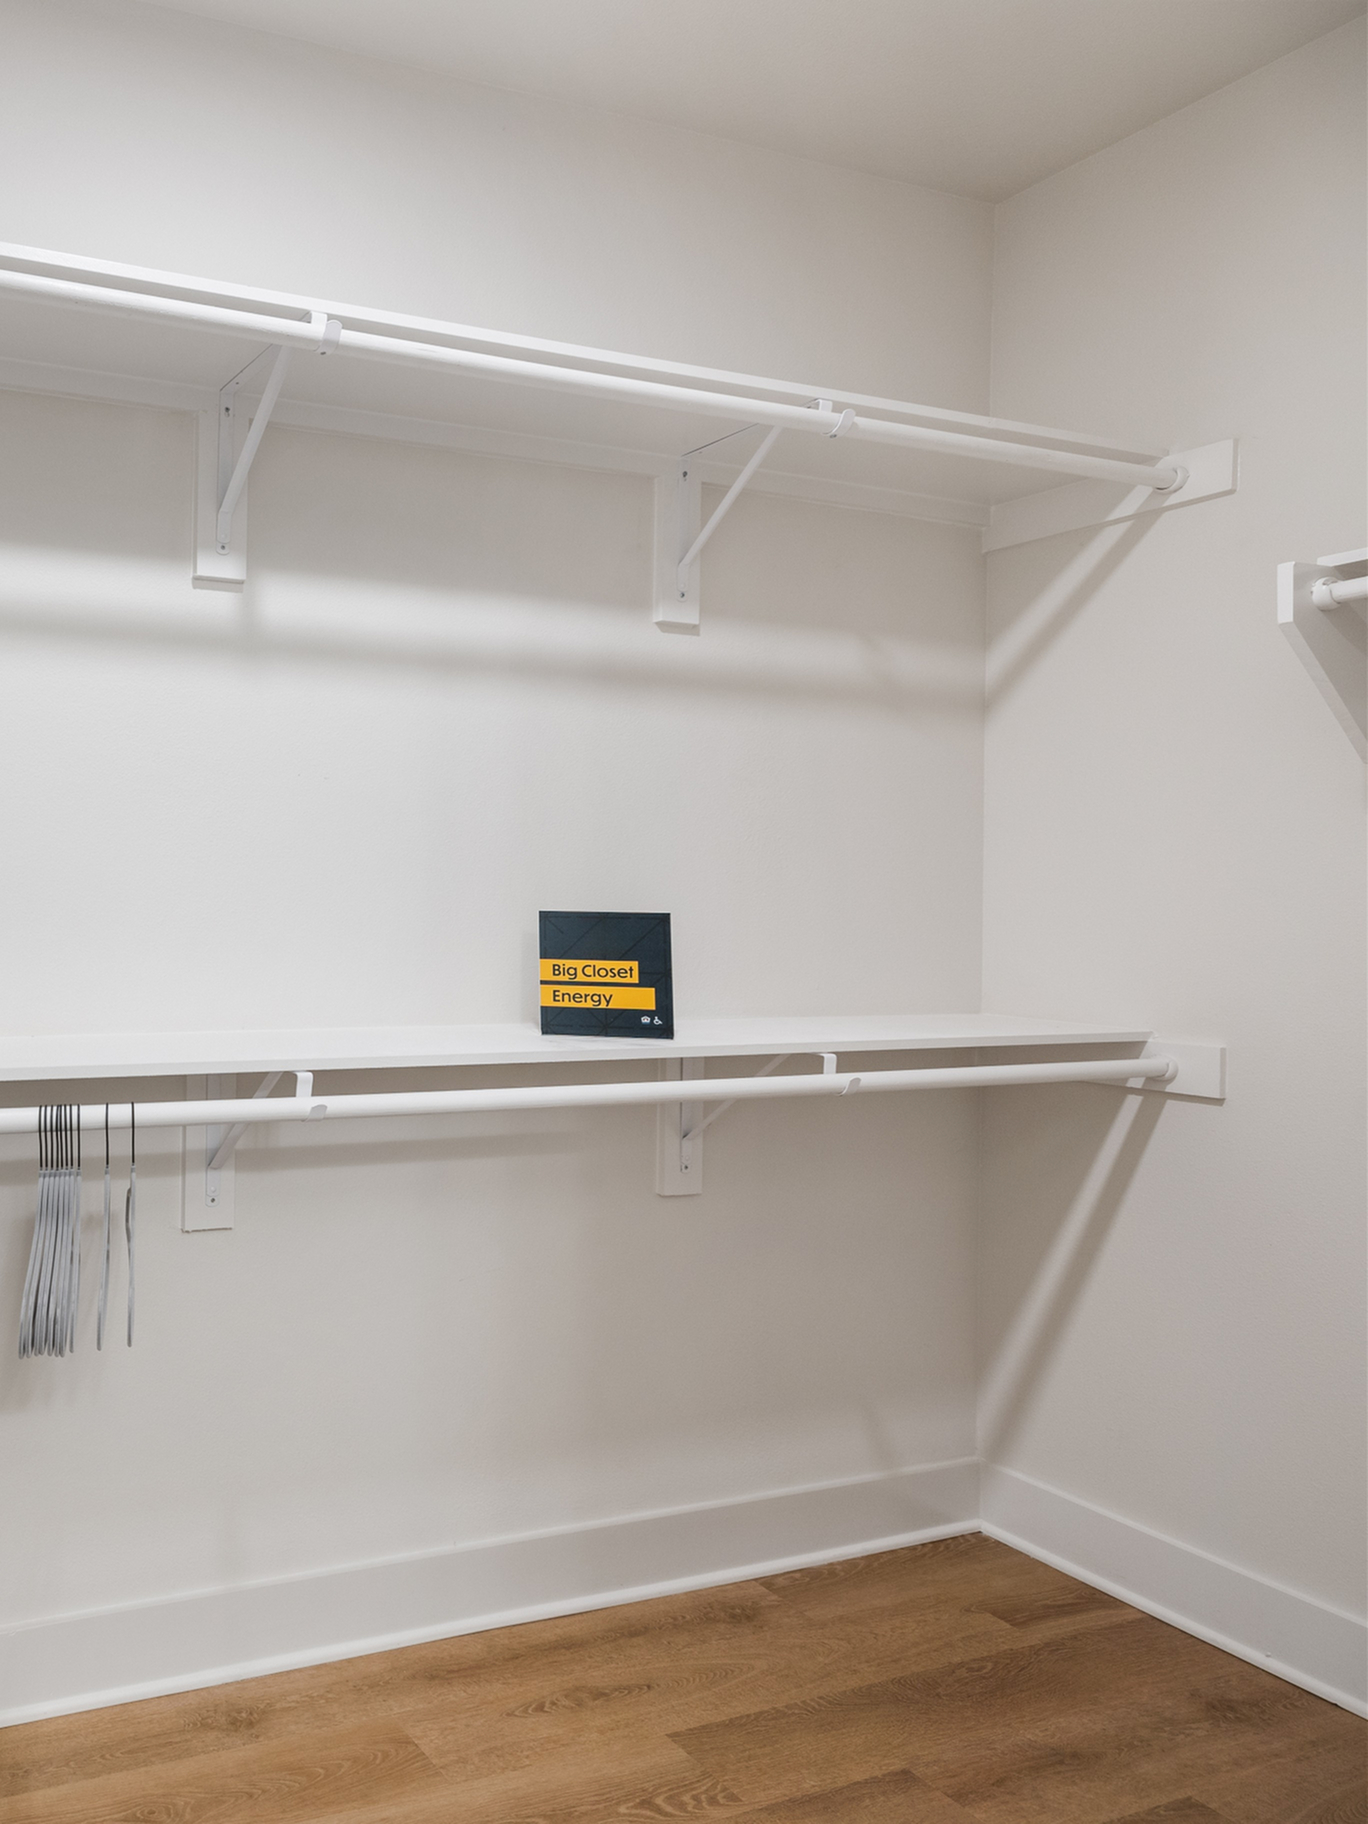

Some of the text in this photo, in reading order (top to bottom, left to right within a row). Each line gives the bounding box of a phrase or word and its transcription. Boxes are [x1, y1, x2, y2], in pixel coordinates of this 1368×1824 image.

[552, 963, 634, 979] Big Closet
[552, 990, 613, 1007] Energy
